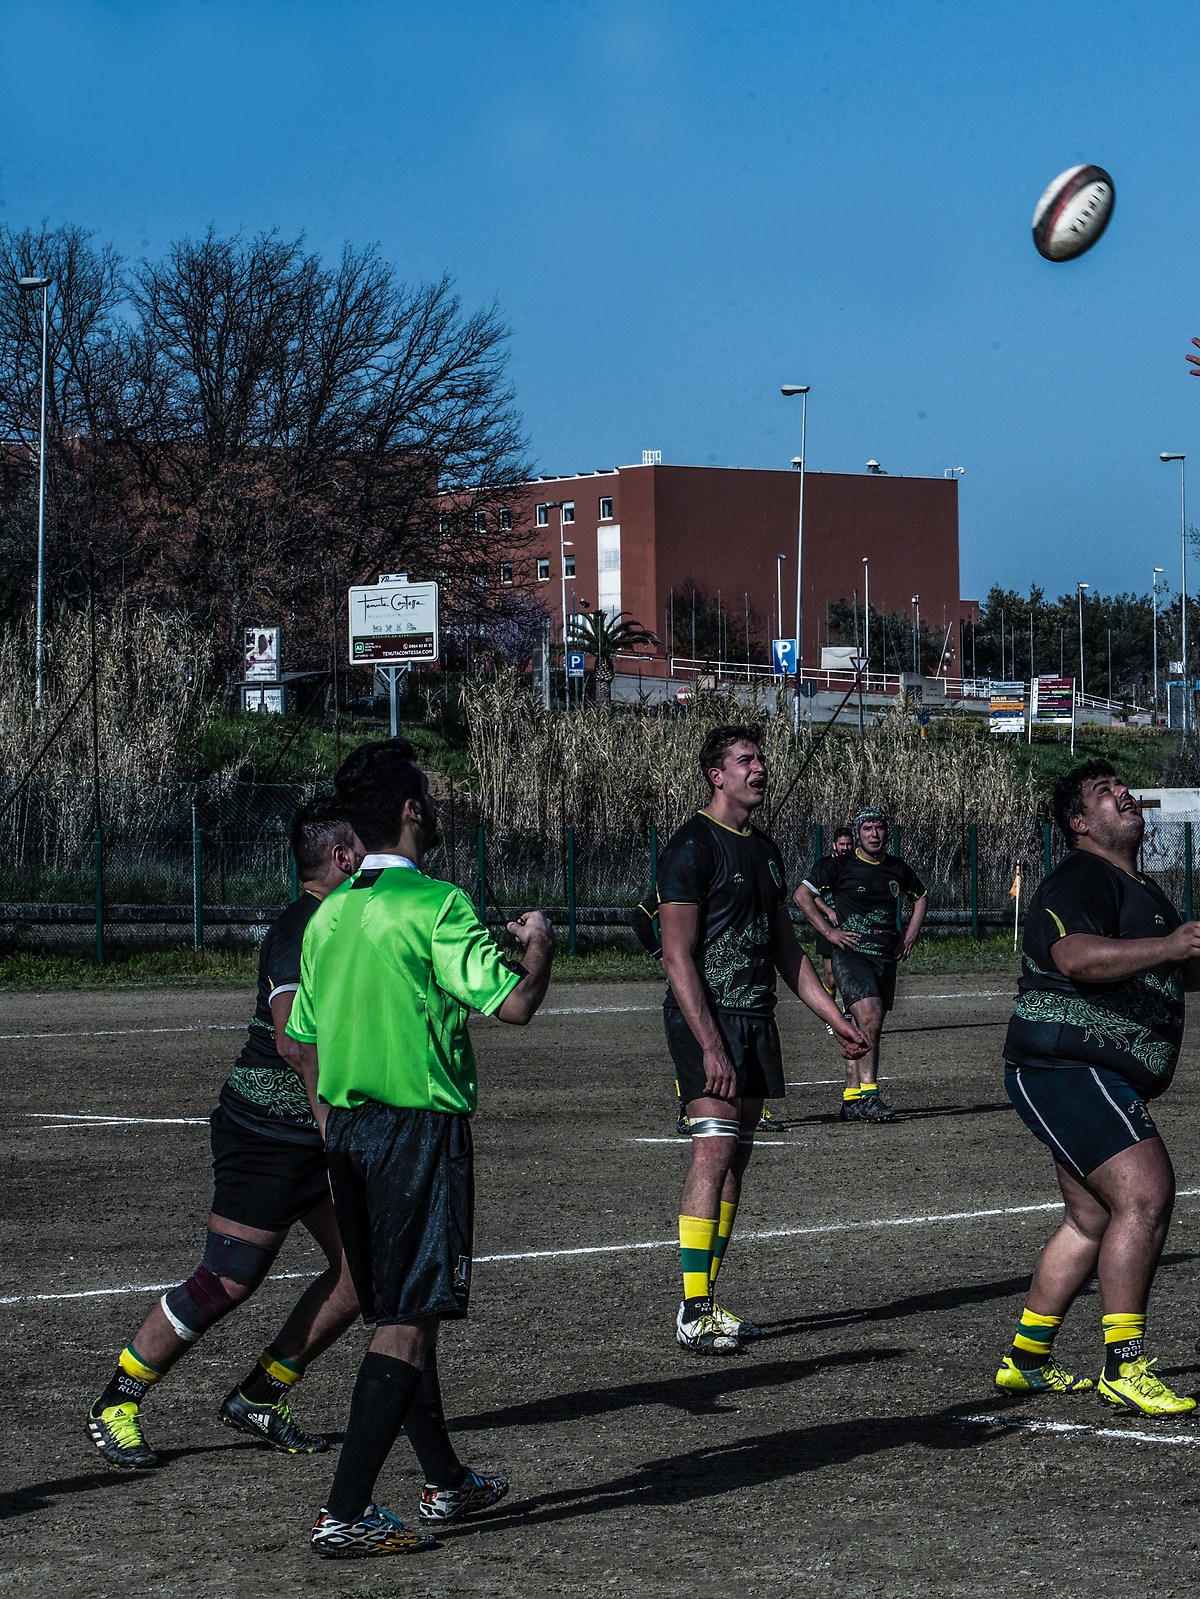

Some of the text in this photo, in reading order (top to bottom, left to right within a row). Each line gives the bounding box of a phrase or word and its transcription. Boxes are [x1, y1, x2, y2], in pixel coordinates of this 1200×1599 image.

[382, 649, 433, 657] TENUTACONTESSA.COM
[778, 642, 791, 659] P
[571, 655, 581, 668] P
[247, 1412, 269, 1434] adidas
